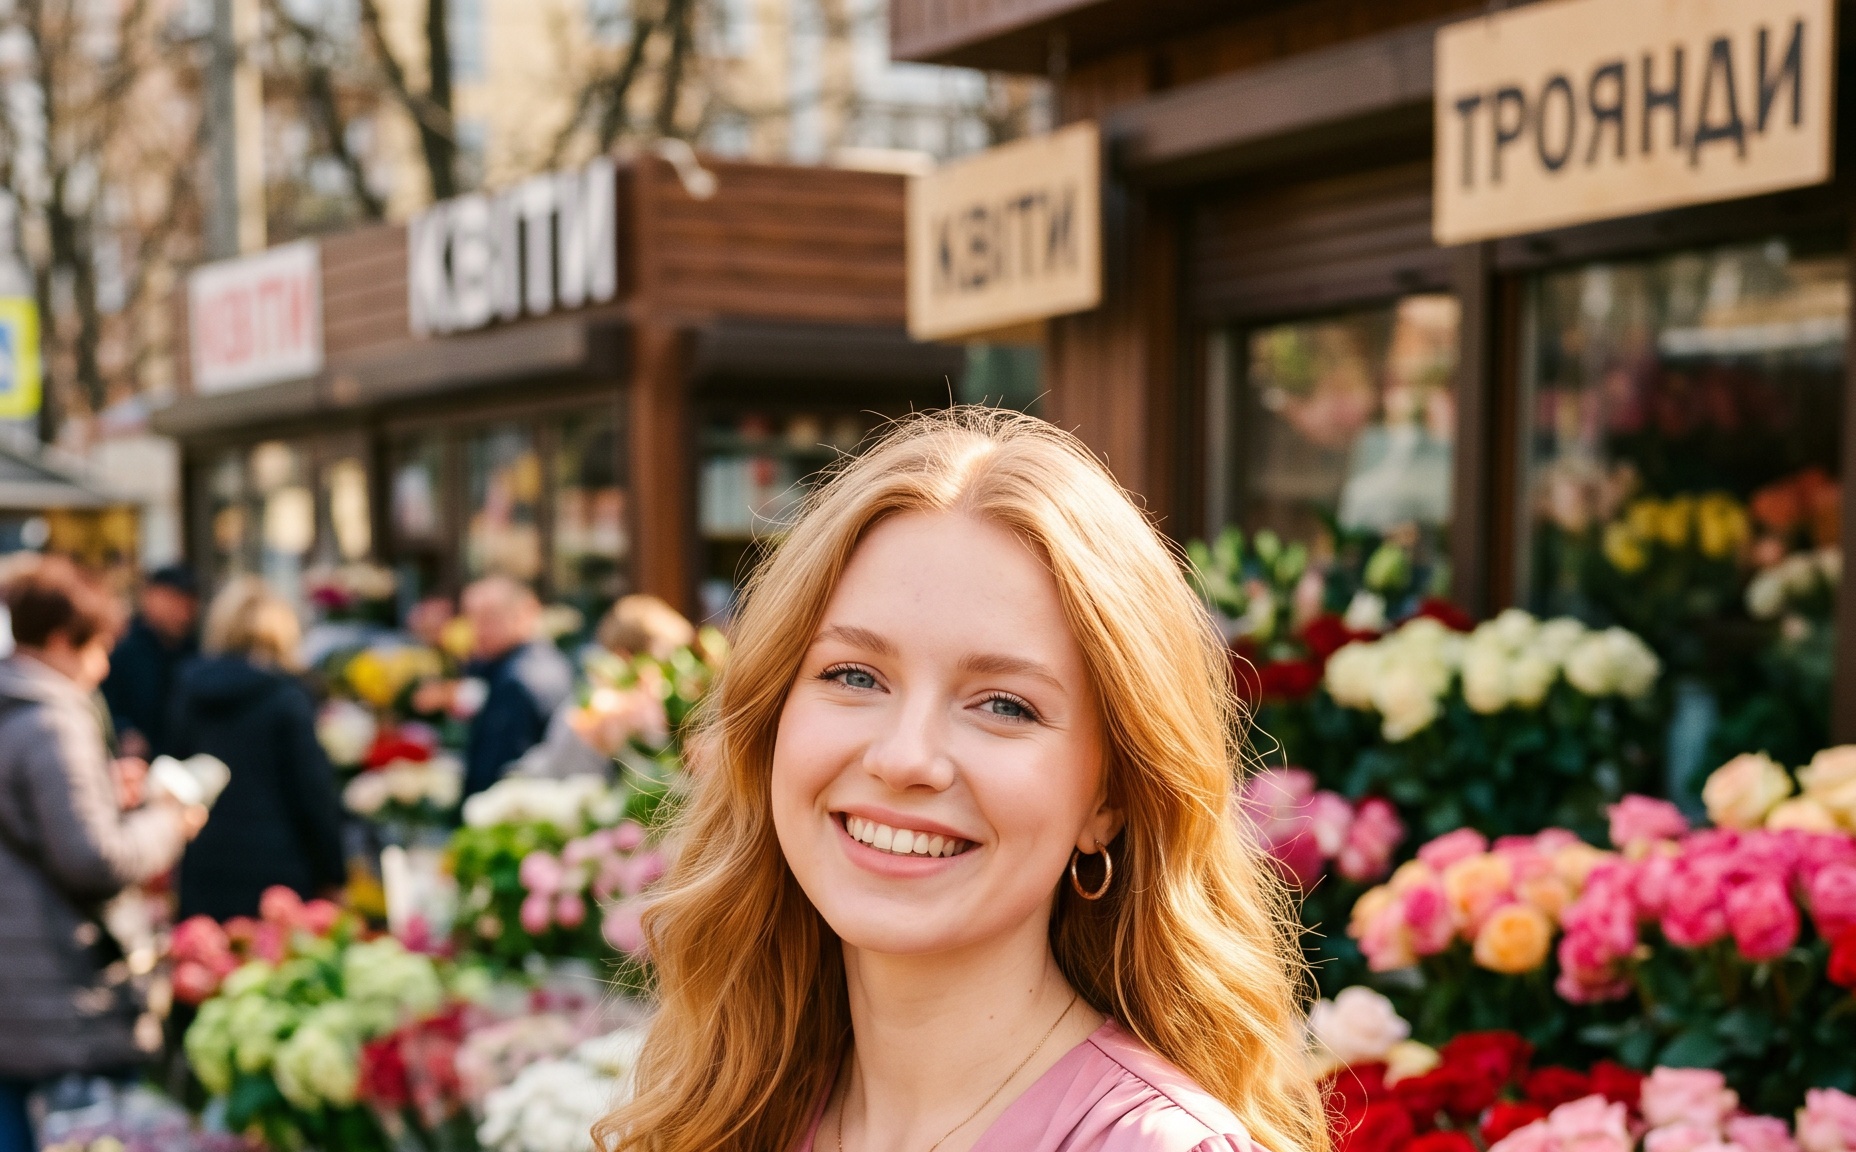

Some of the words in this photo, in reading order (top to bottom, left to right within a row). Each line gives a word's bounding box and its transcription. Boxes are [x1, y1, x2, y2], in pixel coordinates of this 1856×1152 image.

[1455, 18, 1804, 190] ТРОЯНДИ
[409, 157, 617, 336] КВІТИ
[932, 182, 1078, 298] КВІТИ
